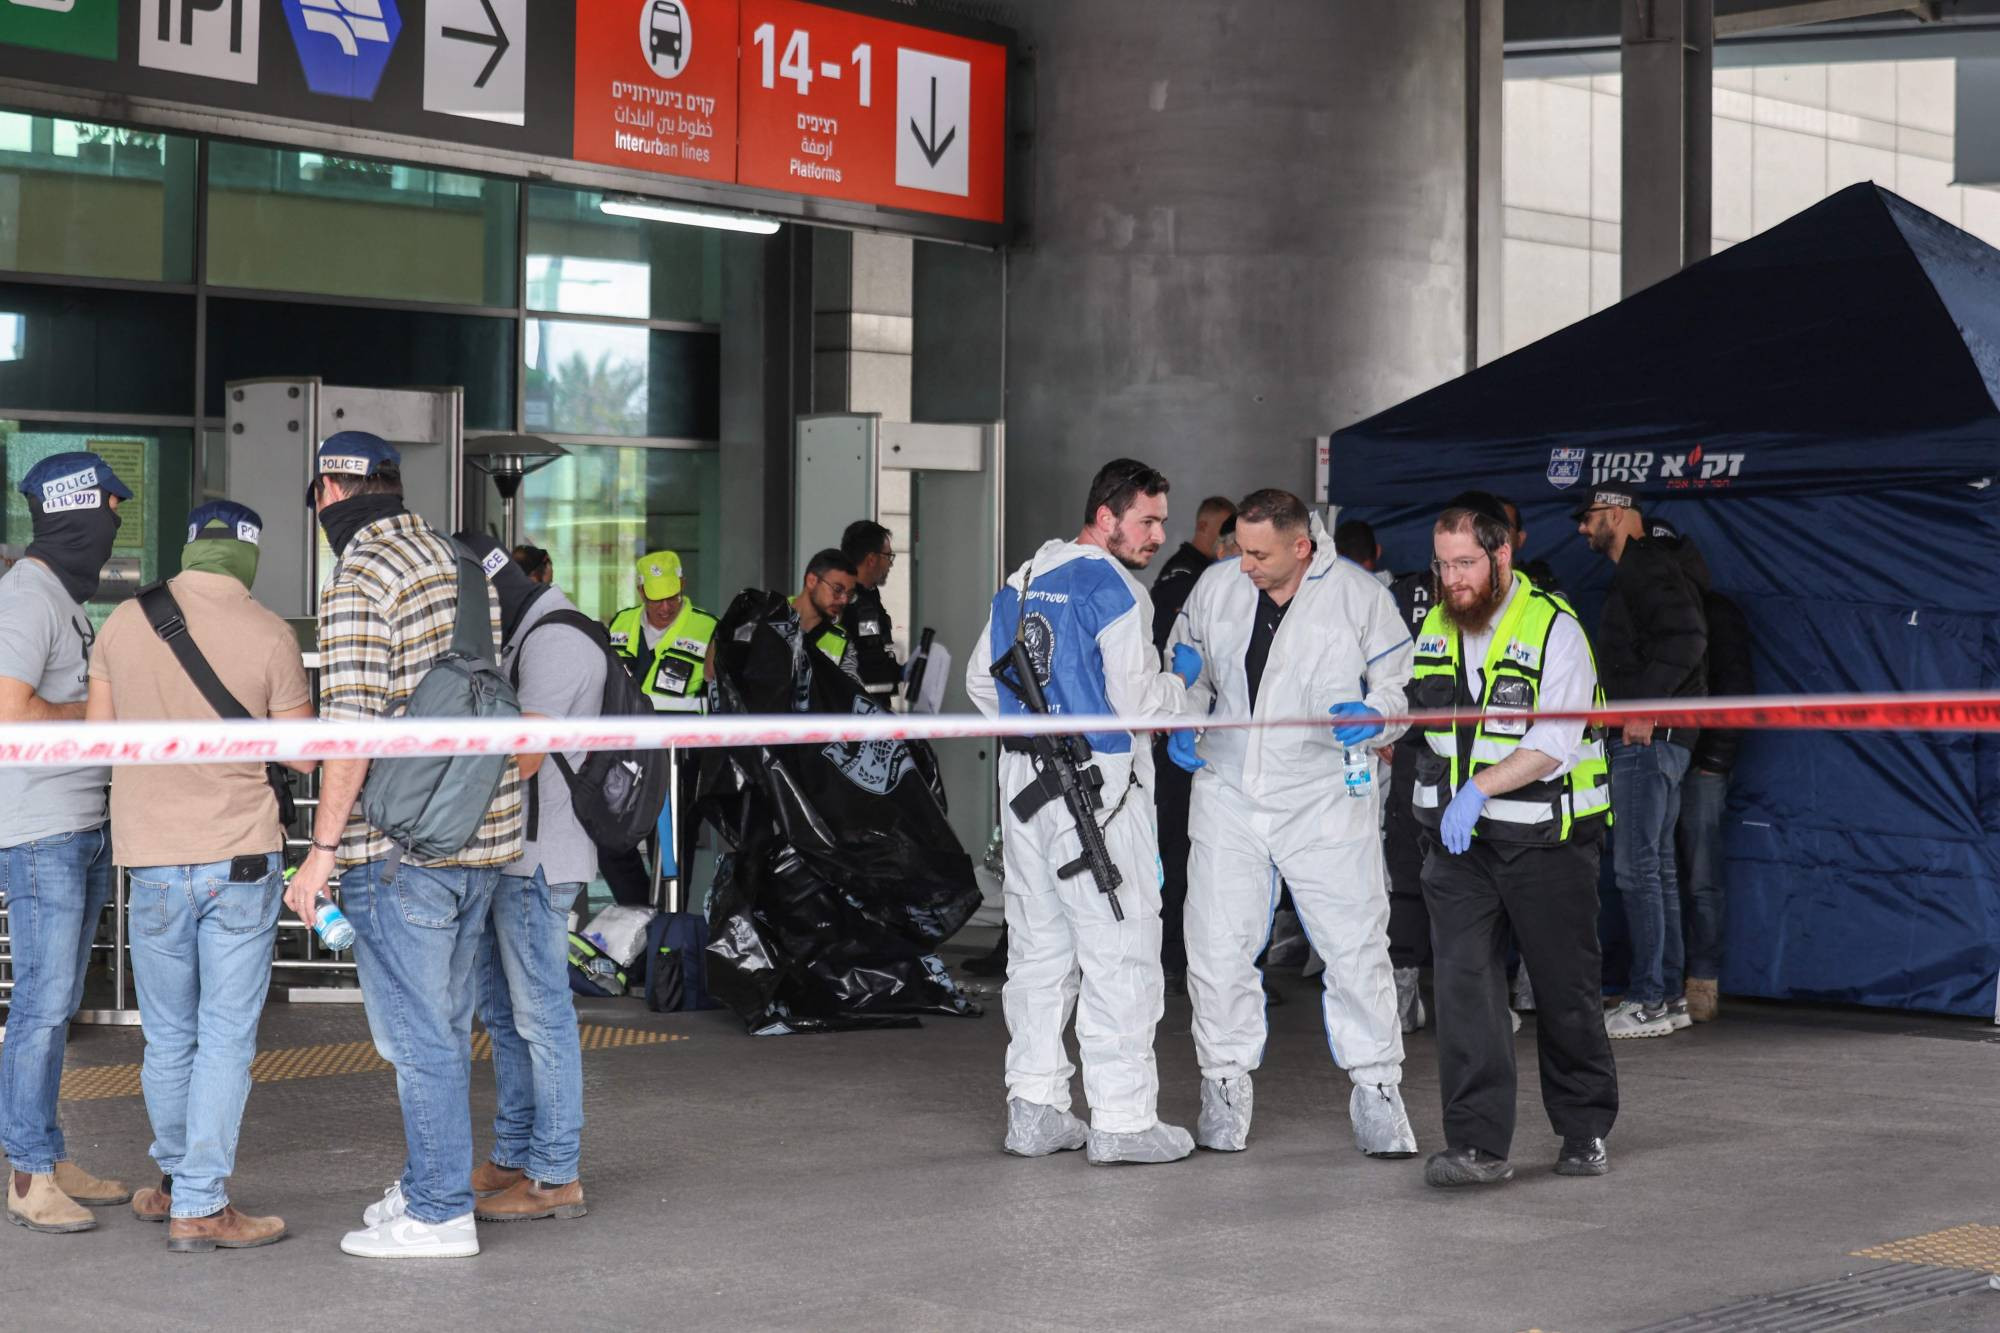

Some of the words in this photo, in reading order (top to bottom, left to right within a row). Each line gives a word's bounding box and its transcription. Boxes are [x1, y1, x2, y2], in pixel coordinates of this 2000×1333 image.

[754, 23, 871, 108] 14-1
[612, 80, 682, 110] בינעירוניים
[686, 94, 715, 118] קוים
[614, 106, 654, 132] البلدات
[656, 117, 675, 136] بين
[677, 115, 713, 140] خطوط
[797, 113, 837, 135] רציפים
[615, 130, 678, 158] Interurban
[681, 141, 711, 163] lines
[789, 158, 842, 183] Platforms
[322, 458, 364, 471] POLICE
[1591, 452, 1654, 468] מחוז
[46, 472, 96, 497] POLICE
[483, 552, 504, 574] ICE
